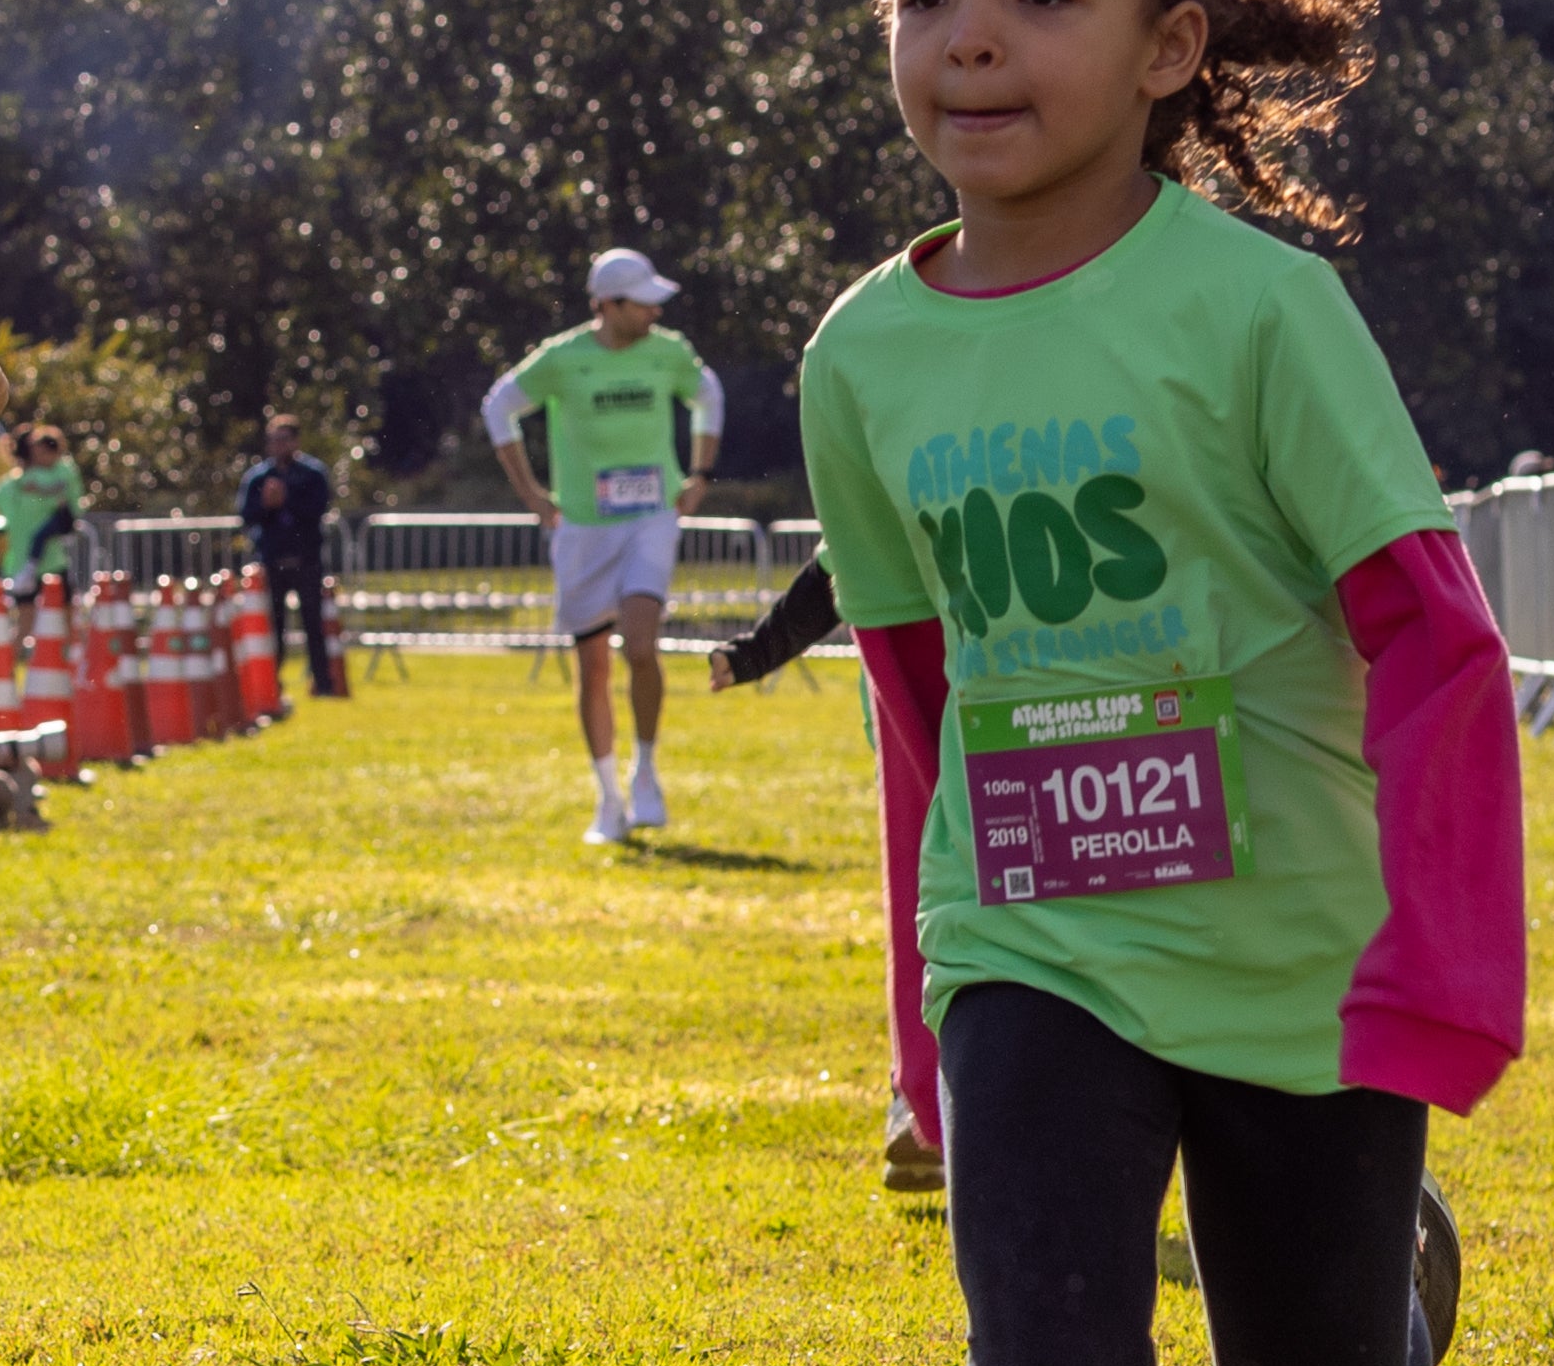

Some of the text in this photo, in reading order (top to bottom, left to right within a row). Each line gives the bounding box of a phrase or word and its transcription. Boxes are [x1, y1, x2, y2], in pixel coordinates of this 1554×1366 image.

[907, 414, 1141, 510] ATHENAS
[918, 473, 1168, 639] KIDS
[993, 605, 1189, 677] STRONGER
[1012, 693, 1143, 729] ATHENAS KIDS
[1028, 715, 1128, 745] RUN STRONGER
[982, 778, 1026, 797] 100m
[1041, 752, 1202, 825] 10121
[987, 825, 1029, 848] 2019
[1070, 824, 1194, 861] PEROLLA
